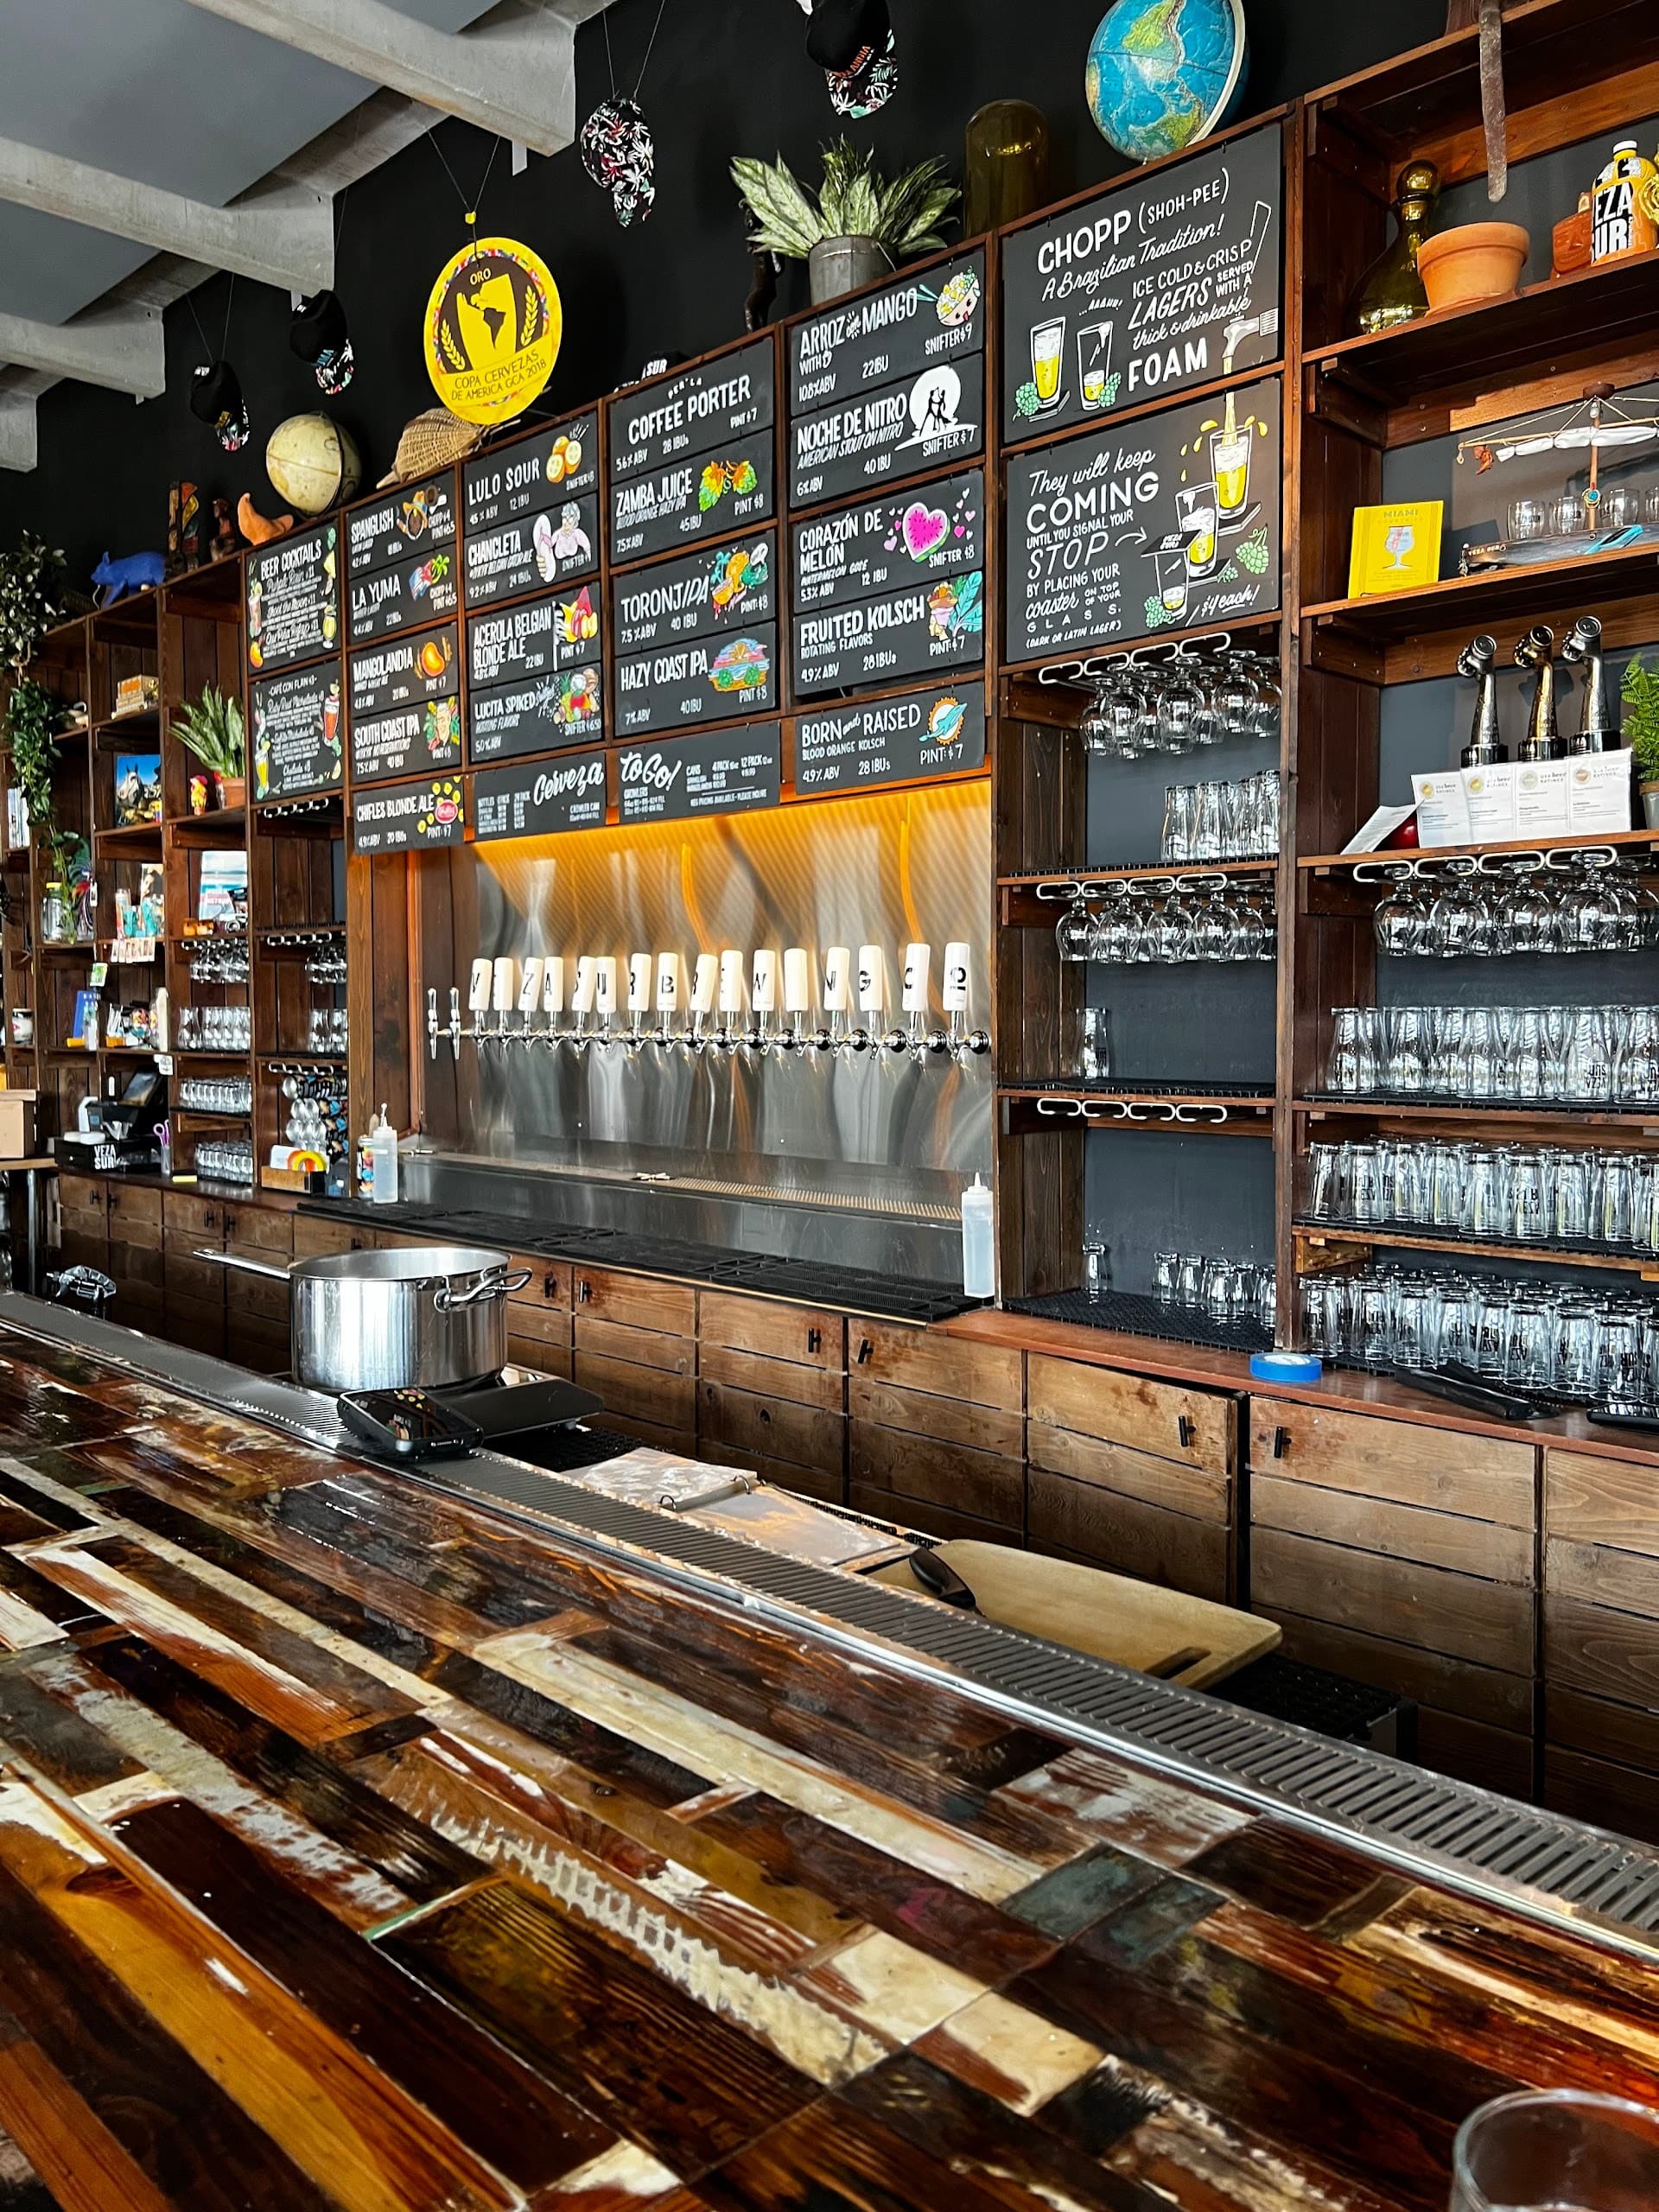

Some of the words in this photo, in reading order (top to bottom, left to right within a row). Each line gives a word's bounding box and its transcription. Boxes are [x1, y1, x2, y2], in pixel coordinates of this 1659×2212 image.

[1594, 181, 1632, 226] EZA
[1037, 210, 1131, 274] CHOPP
[1138, 168, 1229, 233] (SHOH-PEE)
[1041, 277, 1057, 302] A
[1057, 253, 1135, 299] Brazilian
[1139, 213, 1225, 264] Tradition!
[1133, 276, 1154, 299] ICE
[1158, 263, 1192, 289] COLD
[1194, 261, 1205, 276] &
[1206, 238, 1252, 270] CRISP
[1217, 260, 1253, 283] SERVED
[470, 268, 491, 285] ORO
[1216, 276, 1239, 297] WITH
[1243, 272, 1252, 288] A
[1128, 276, 1211, 330] LAGERS
[800, 315, 846, 359] ARROZ
[861, 288, 917, 335] MANGO
[1133, 322, 1168, 350] thick
[1170, 321, 1181, 336] &
[1181, 295, 1252, 333] drinkable
[925, 331, 960, 355] SNIFTER
[454, 374, 480, 390] COPA
[484, 349, 539, 384] CERVEZAS
[646, 359, 668, 377] SUR
[799, 354, 822, 376] WITH
[1128, 337, 1207, 391] FOAM
[451, 391, 462, 401] DE
[467, 383, 503, 400] AMERICA
[505, 375, 524, 389] GCA
[527, 360, 547, 378] 2018
[628, 401, 683, 444] COFFEE
[688, 374, 751, 422] PORTER
[730, 413, 746, 429] PINT
[798, 413, 842, 454] NOCHE
[843, 407, 862, 438] DE
[864, 392, 907, 431] NITRO
[634, 448, 648, 465] ABV
[798, 443, 838, 470] AMERICAN
[840, 434, 863, 456] STOUT
[863, 432, 874, 449] ON
[873, 422, 905, 444] NITRO
[923, 434, 959, 457] SNIFTER
[864, 459, 876, 474] 40
[877, 453, 891, 472] IBU
[1029, 469, 1066, 497] They
[1072, 451, 1110, 484] will
[1113, 447, 1155, 474] keep
[468, 474, 500, 506] LULO
[505, 458, 540, 491] SOUR
[616, 481, 655, 518] ZAMBA
[657, 468, 693, 502] JUICE
[658, 499, 676, 516] HAZY
[734, 497, 752, 515] PINT
[1027, 472, 1159, 534] COMING
[352, 507, 394, 543] SPANGLISH
[800, 512, 859, 553] CORAZÓN
[864, 508, 884, 533] DE
[1027, 534, 1052, 550] UNTIL
[1053, 528, 1070, 542] YOU
[1072, 520, 1108, 537] SIGNAL
[1109, 509, 1134, 526] YOUR
[261, 556, 279, 581] BEER
[282, 539, 321, 571] COCKTAILS
[468, 530, 521, 567] CHANCLETA
[799, 543, 845, 575] MELÓN
[928, 550, 962, 569] SNIFTER
[1027, 531, 1109, 580] STOP
[801, 566, 846, 587] WATERMELON
[819, 582, 835, 598] ABV
[861, 573, 871, 587] 12
[873, 567, 887, 583] IBU
[1027, 583, 1039, 598] BY
[1045, 571, 1088, 594] PLACING
[1091, 563, 1120, 582] YOUR
[1084, 588, 1096, 597] ON
[1100, 582, 1119, 594] TOP
[353, 588, 366, 611] LA
[368, 574, 401, 603] YUMA
[1026, 592, 1079, 620] coaster
[1085, 597, 1096, 606] OF
[1099, 589, 1121, 602] YOUR
[1218, 584, 1260, 608] each!
[474, 618, 513, 649] ACEROLA
[515, 607, 551, 639] BELGIAN
[640, 623, 657, 638] ABV
[683, 613, 697, 628] IBU
[800, 610, 864, 647] FRUITED
[867, 594, 925, 635] KOLSCH
[1026, 633, 1050, 649] (DARK
[1052, 633, 1062, 643] OR
[1065, 626, 1087, 640] LATIN
[1090, 620, 1122, 635] LAGER)
[474, 641, 506, 671] BLONDE
[507, 637, 526, 662] ALE
[561, 645, 574, 659] PINT
[800, 641, 836, 660] ROTATING
[839, 632, 874, 652] FLAVORS
[863, 654, 874, 671] 28
[874, 650, 897, 670] IBUs
[353, 646, 413, 683] MANGOLANDIA
[620, 662, 651, 691] HAZY
[654, 652, 688, 684] COAST
[690, 649, 709, 677] IPA
[823, 662, 840, 678] ABV
[475, 698, 504, 720] LUCITA
[505, 691, 536, 714] SPIKED
[739, 690, 755, 703] PINT
[637, 708, 651, 721] ABV
[802, 718, 842, 747] BORN
[842, 712, 861, 735] and
[863, 703, 921, 735] RAISED
[354, 722, 380, 748] SOUTH
[380, 716, 406, 742] COAST
[406, 714, 420, 736] IPA
[802, 747, 825, 761] BLOOD
[826, 741, 855, 758] ORANGE
[858, 736, 886, 752] KOLSCH
[823, 766, 840, 780] ABV
[858, 760, 870, 776] 28
[871, 757, 891, 774] IBUs
[533, 762, 604, 805] Cerveza
[357, 801, 385, 822] CHIFLES
[386, 797, 416, 817] BLONDE
[418, 794, 435, 813] ALE
[93, 1144, 116, 1156] VEZA
[94, 1156, 115, 1170] SUR
